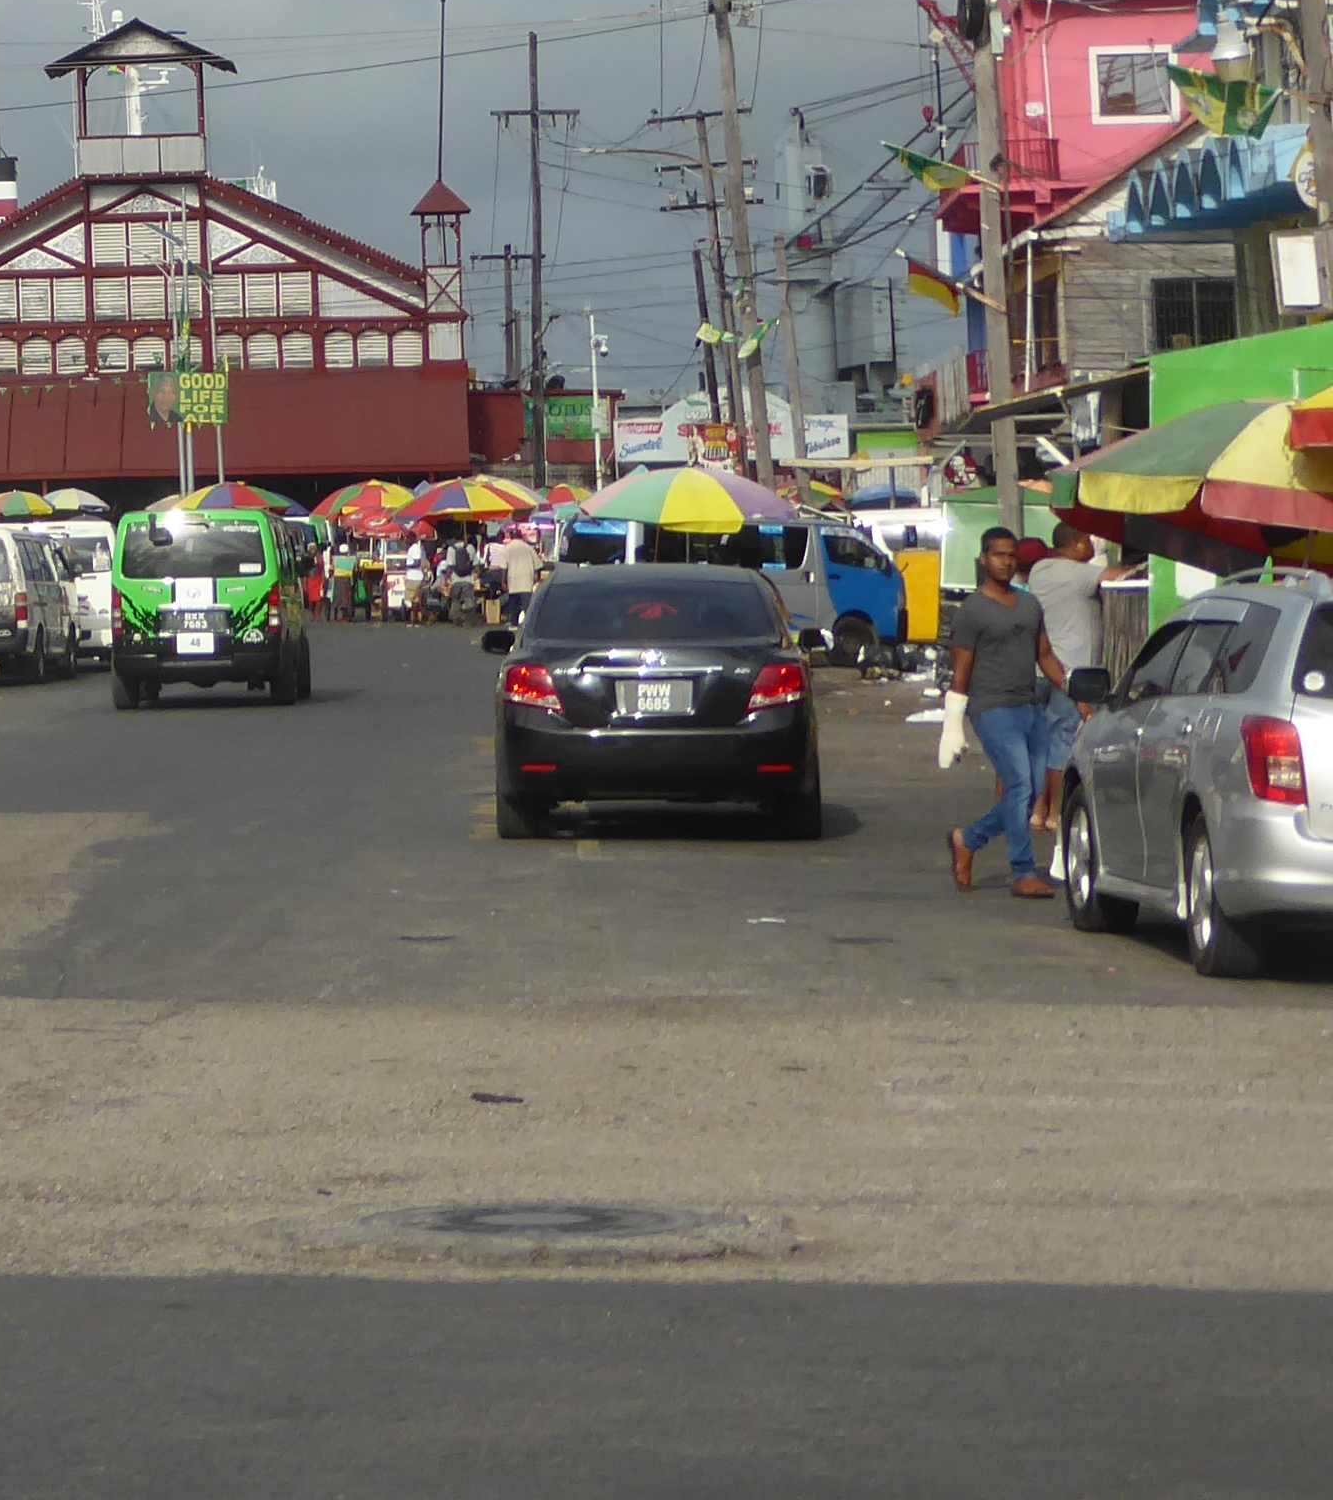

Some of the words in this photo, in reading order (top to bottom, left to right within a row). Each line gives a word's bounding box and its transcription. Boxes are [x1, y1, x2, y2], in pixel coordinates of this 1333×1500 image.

[179, 373, 226, 389] GOOD
[180, 390, 224, 404] LIFE
[180, 404, 224, 414] FOR
[548, 403, 591, 416] OTUS
[183, 414, 223, 423] ALL
[637, 683, 671, 697] PWW
[637, 698, 671, 710] 6685
